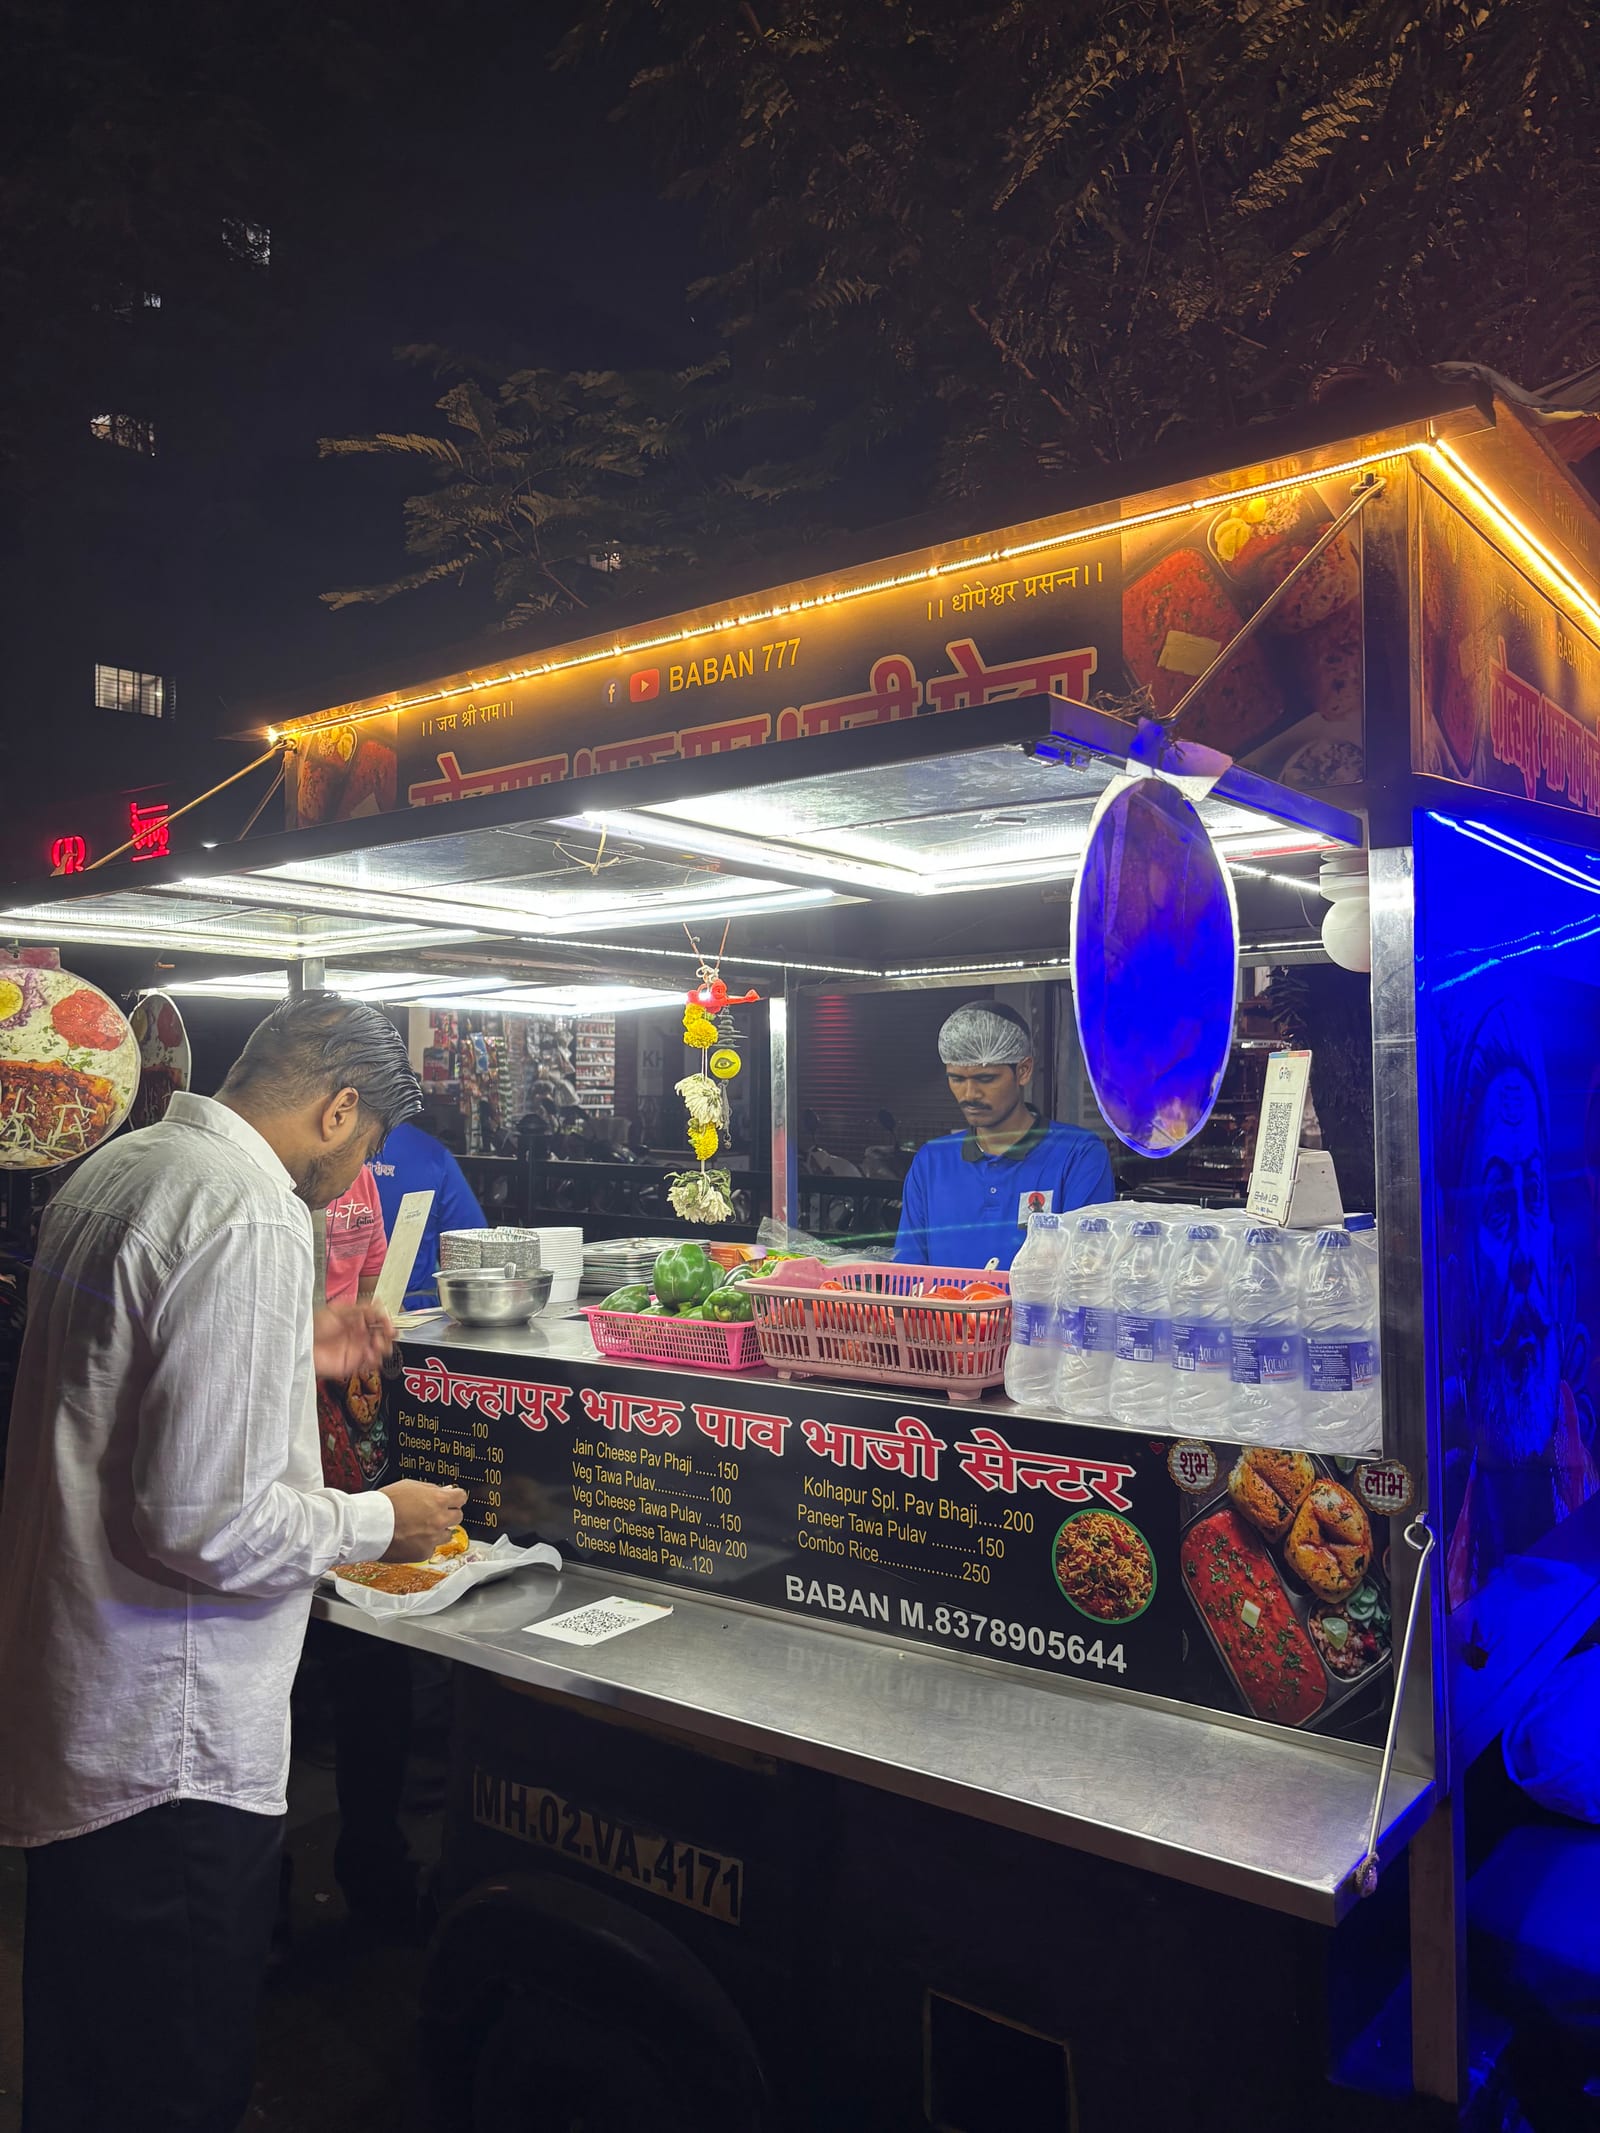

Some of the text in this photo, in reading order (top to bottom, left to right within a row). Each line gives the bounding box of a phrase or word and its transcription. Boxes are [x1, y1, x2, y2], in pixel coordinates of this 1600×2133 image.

[669, 648, 754, 693] BABAN
[762, 637, 801, 672] 777
[436, 714, 458, 733] जय
[461, 703, 477, 728] श्री
[398, 1411, 416, 1427] Pav
[417, 1413, 440, 1434] Bhaji
[402, 1356, 573, 1431] कोल्हापुर
[579, 1388, 685, 1437] भाऊ
[691, 1403, 792, 1455] पाव
[801, 1415, 947, 1482] भाजी
[954, 1427, 1136, 1512] सेन्टर
[398, 1432, 432, 1451] Cheese
[433, 1437, 451, 1454] Pav
[572, 1438, 594, 1457] Jain
[596, 1441, 637, 1463] Cheese
[640, 1448, 661, 1468] Pav
[664, 1452, 693, 1477] Phaji
[399, 1452, 416, 1469] Jain
[418, 1456, 435, 1472] Pav
[572, 1461, 592, 1483] Veg
[595, 1465, 622, 1485] Tawa
[1180, 1452, 1209, 1484] शुभ
[804, 1475, 868, 1507] Kolhapur
[904, 1493, 934, 1516] Pav
[1365, 1470, 1404, 1499] लाभ
[572, 1484, 592, 1508] Veg
[595, 1489, 636, 1512] Cheese
[639, 1497, 667, 1518] Tawa
[670, 1503, 702, 1525] Pulav
[573, 1508, 747, 1559] Paneer Cheese Tawa Pulav 200
[798, 1503, 844, 1529] Paneer
[848, 1513, 883, 1537] Tawa
[887, 1520, 927, 1544] Pulav
[576, 1531, 616, 1553] Cheese
[619, 1540, 658, 1563] Masala
[798, 1530, 845, 1556] Combo
[785, 1574, 889, 1621] BABAN
